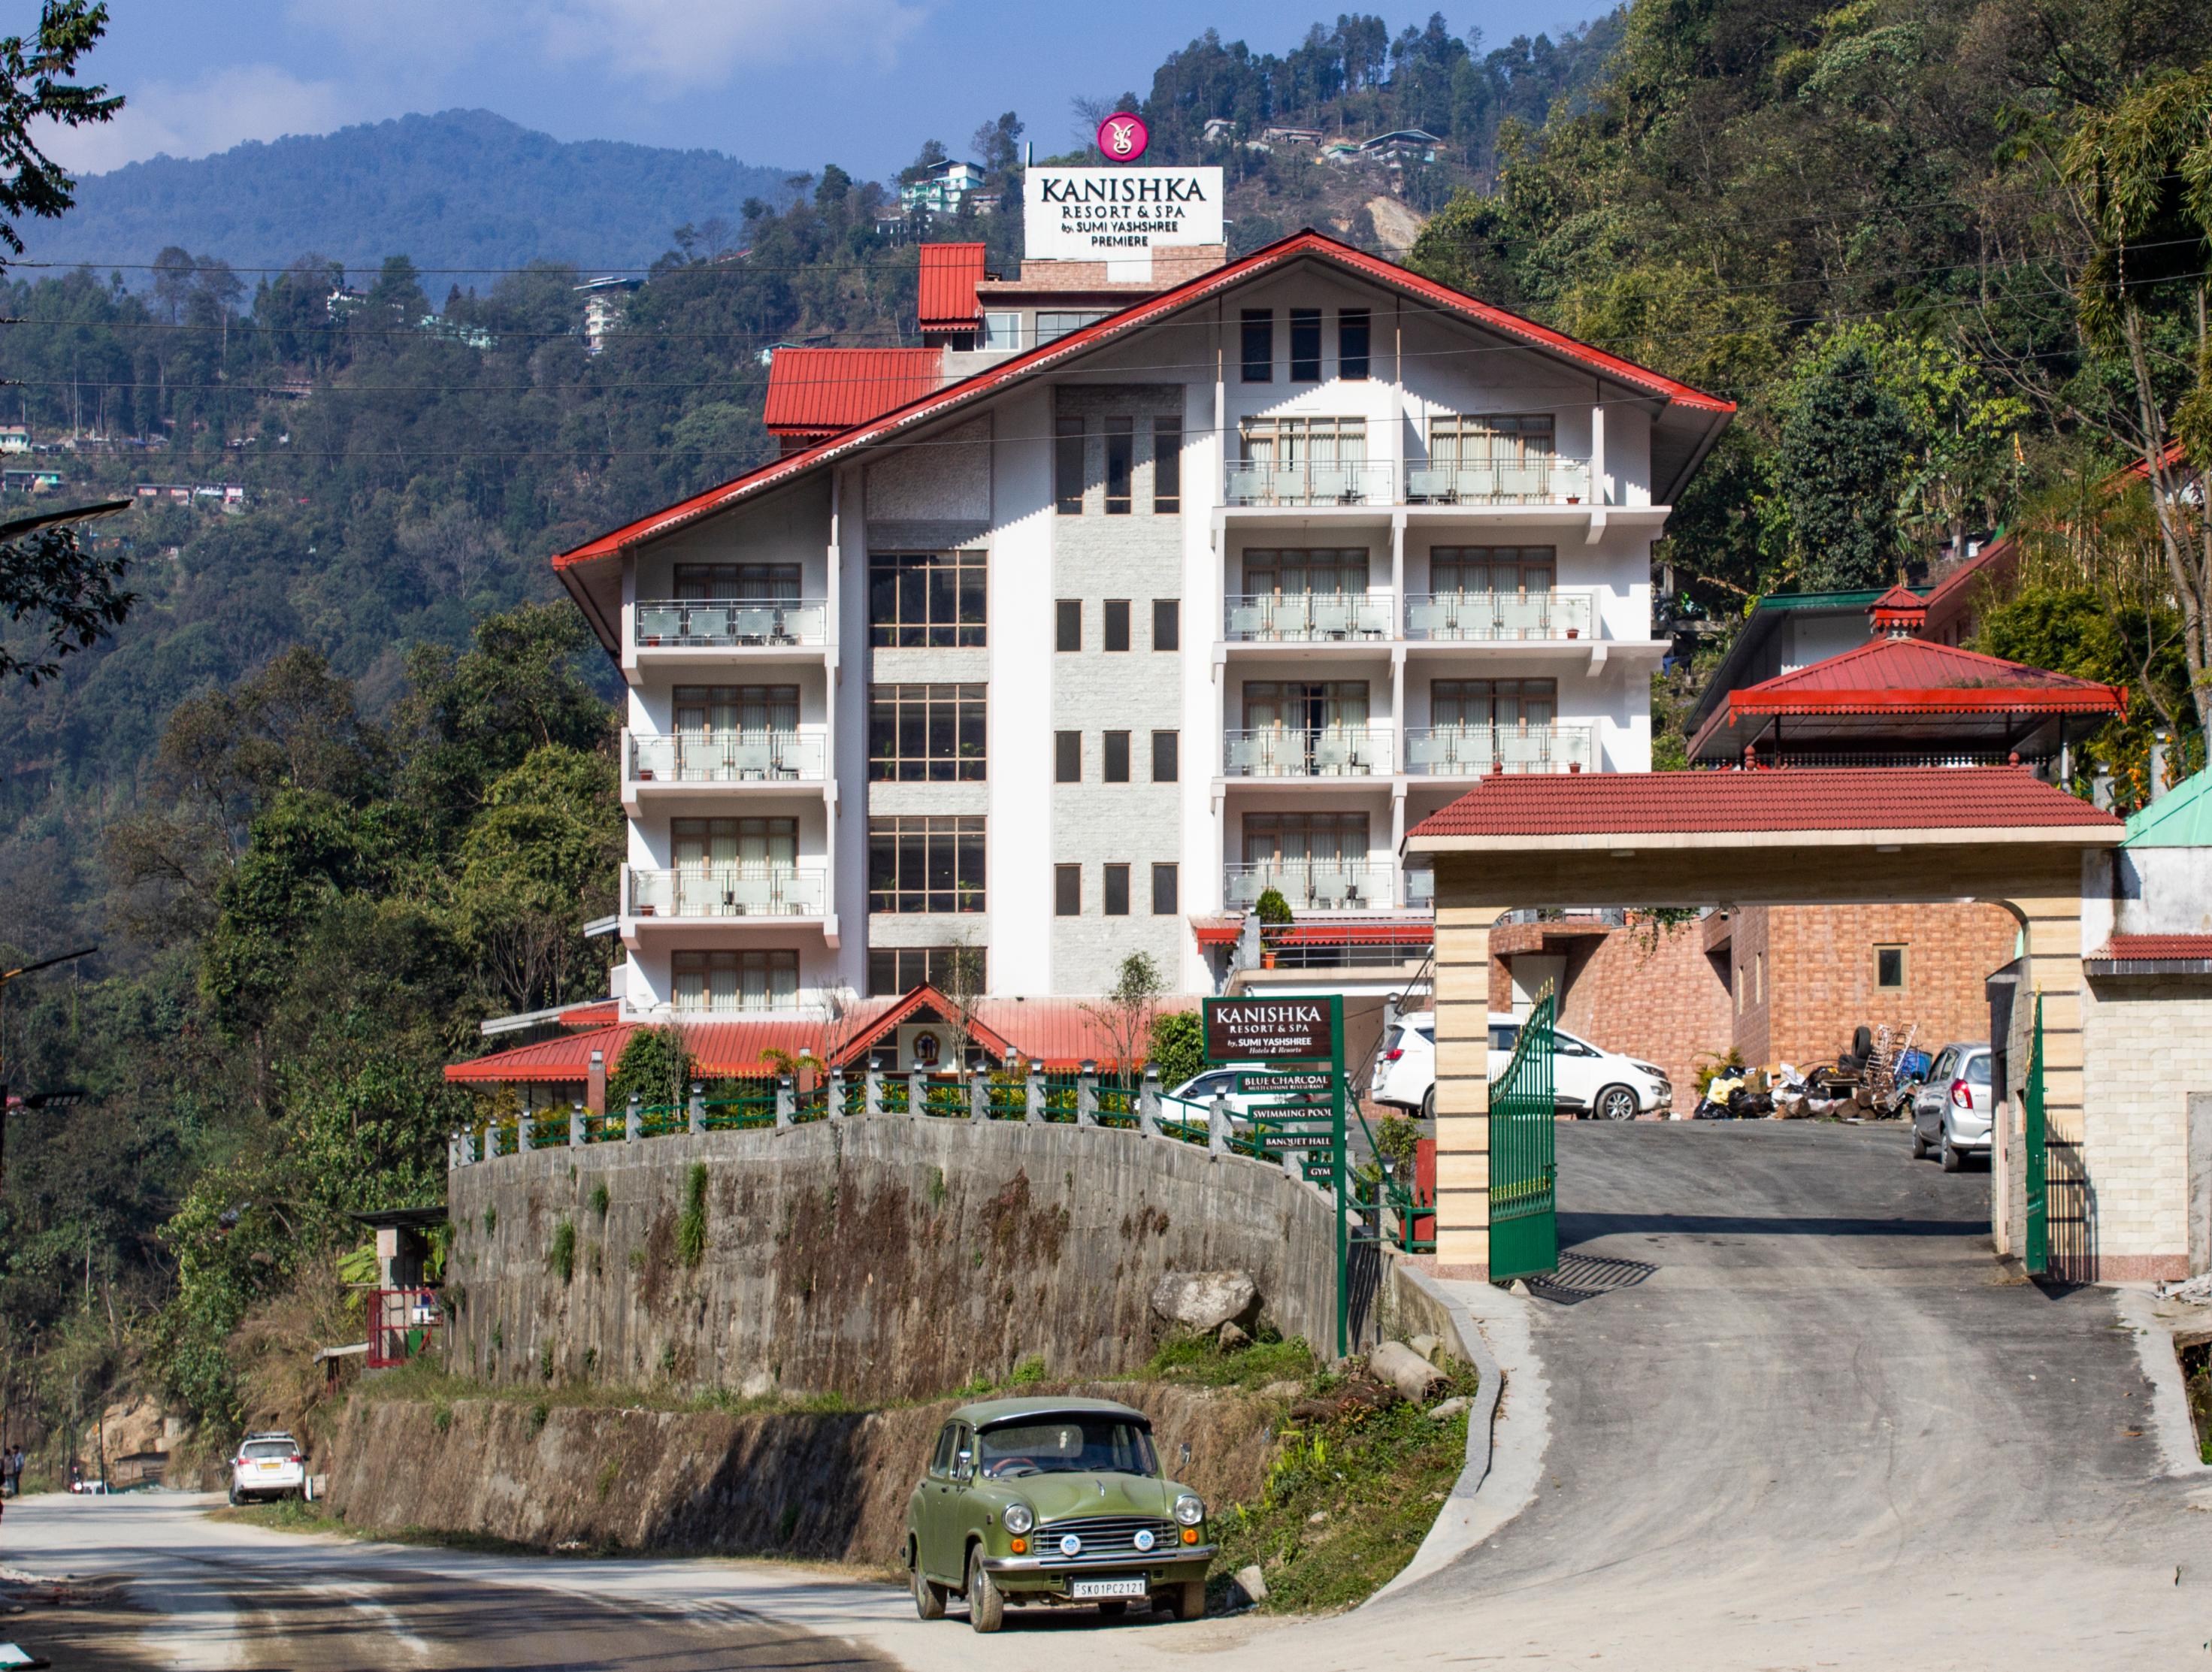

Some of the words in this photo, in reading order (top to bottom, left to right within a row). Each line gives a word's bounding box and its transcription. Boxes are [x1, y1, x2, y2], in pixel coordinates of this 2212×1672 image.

[1041, 178, 1206, 201] KANISHKA
[1062, 206, 1132, 218] RESORT
[1137, 206, 1149, 218] &
[1155, 206, 1185, 218] SPA
[1076, 222, 1107, 232] SUMI
[1111, 221, 1178, 232] YASHSHREE
[1091, 236, 1148, 246] PREMIERE
[1217, 1006, 1321, 1023] KANISHKA
[1230, 1025, 1274, 1033] RESORT
[1289, 1023, 1309, 1033] SPA
[1239, 1039, 1261, 1047] SUMI
[1263, 1038, 1312, 1046] YASHSHREE
[1245, 1077, 1269, 1085] BLUE
[1272, 1075, 1328, 1084] CHARCOAL
[1253, 1109, 1306, 1118] SWIMMING
[1308, 1108, 1333, 1117] POOL
[1266, 1138, 1306, 1146] BANQUET
[1309, 1137, 1331, 1145] HALL
[1311, 1167, 1330, 1175] GYM
[1082, 1583, 1142, 1595] SK01PC2121
